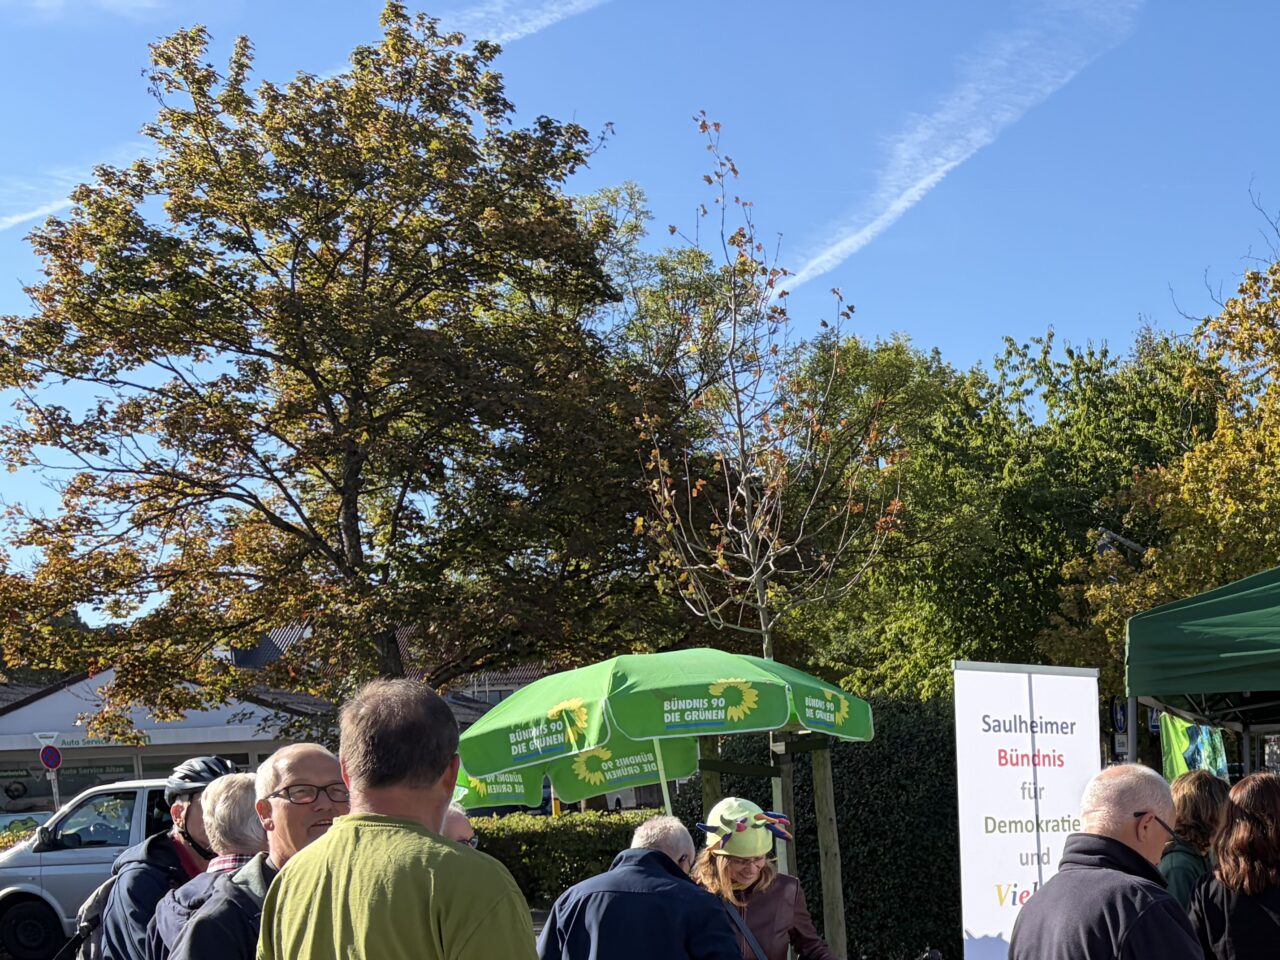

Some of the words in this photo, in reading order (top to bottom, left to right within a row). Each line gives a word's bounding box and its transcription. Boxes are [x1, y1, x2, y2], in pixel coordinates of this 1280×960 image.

[663, 697, 709, 711] BÜNDNIS
[711, 697, 726, 708] 90
[805, 696, 826, 710] BÜNDNIS
[825, 701, 835, 712] 90
[664, 711, 681, 723] DIE
[684, 708, 726, 721] GRÜNEN
[805, 707, 814, 718] DIE
[815, 709, 835, 722] GRÜNEN
[509, 723, 548, 744] BÜNDNIS
[550, 720, 564, 733] 90
[981, 714, 1077, 736] Saulheimer
[61, 738, 80, 746] Auto
[511, 742, 528, 756] DIE
[529, 732, 565, 751] GRÜNEN
[997, 748, 1065, 769] Bündnis
[1020, 781, 1045, 801] für
[984, 814, 1082, 835] Demokratie
[1019, 846, 1051, 867] und
